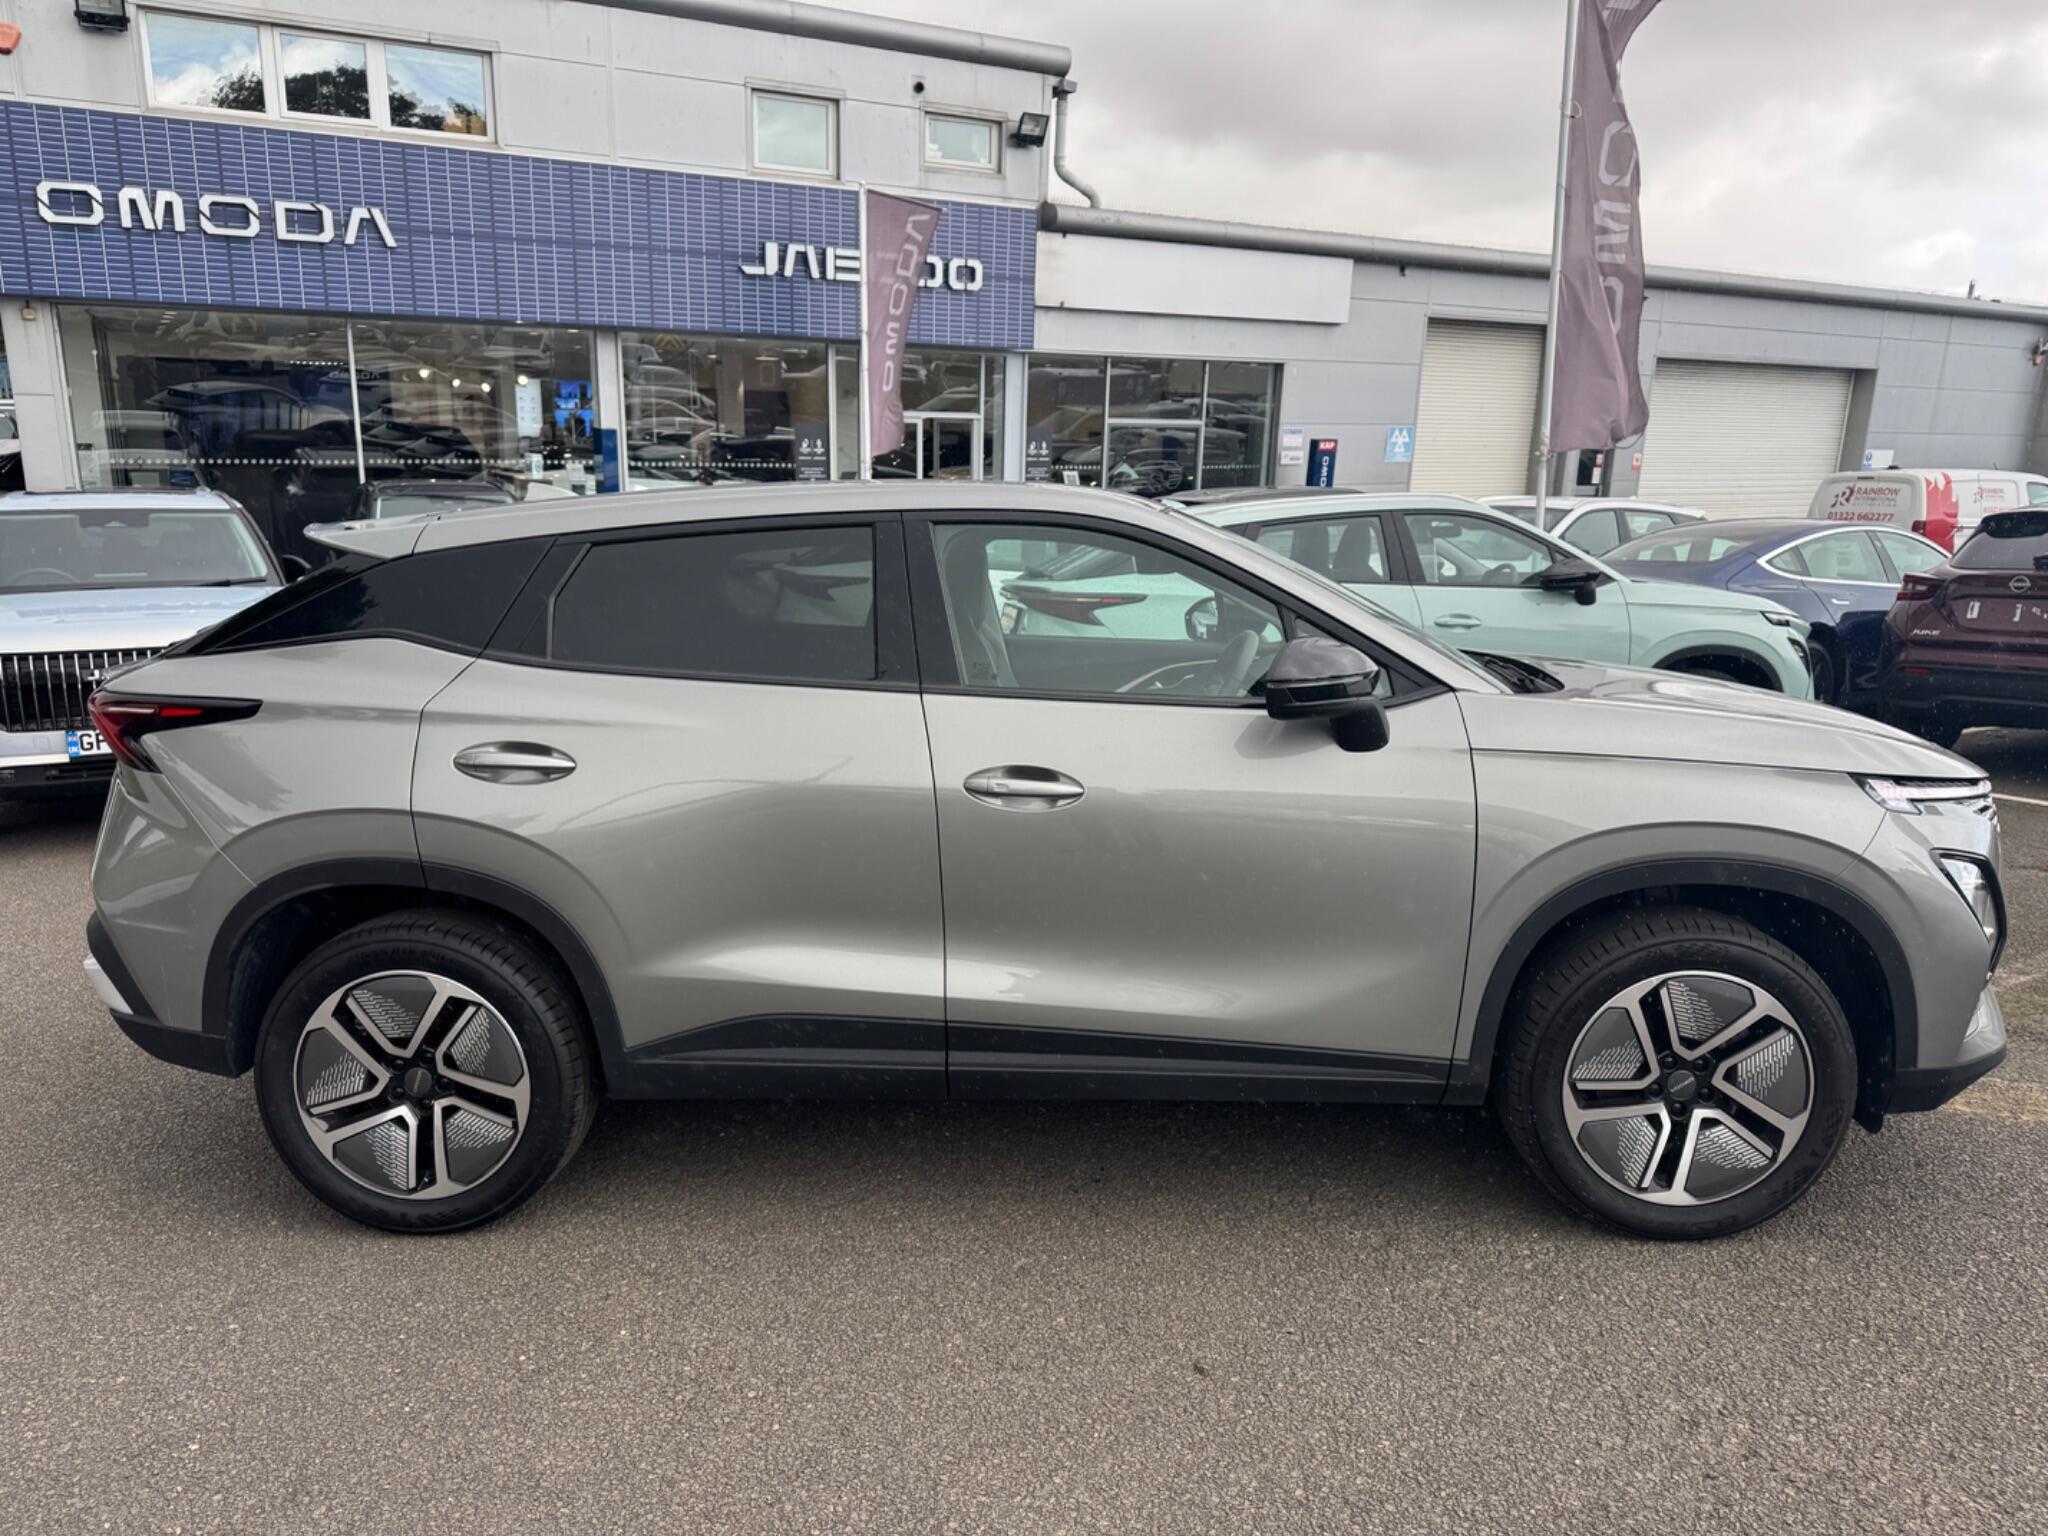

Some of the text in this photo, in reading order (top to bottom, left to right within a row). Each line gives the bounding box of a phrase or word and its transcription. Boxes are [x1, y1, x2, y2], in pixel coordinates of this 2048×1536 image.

[36, 180, 397, 248] OMODA
[740, 241, 984, 291] JAEOO
[882, 213, 931, 392] OMODA
[1827, 511, 1894, 522] 01322 662277
[1855, 486, 1902, 497] RAINBOW
